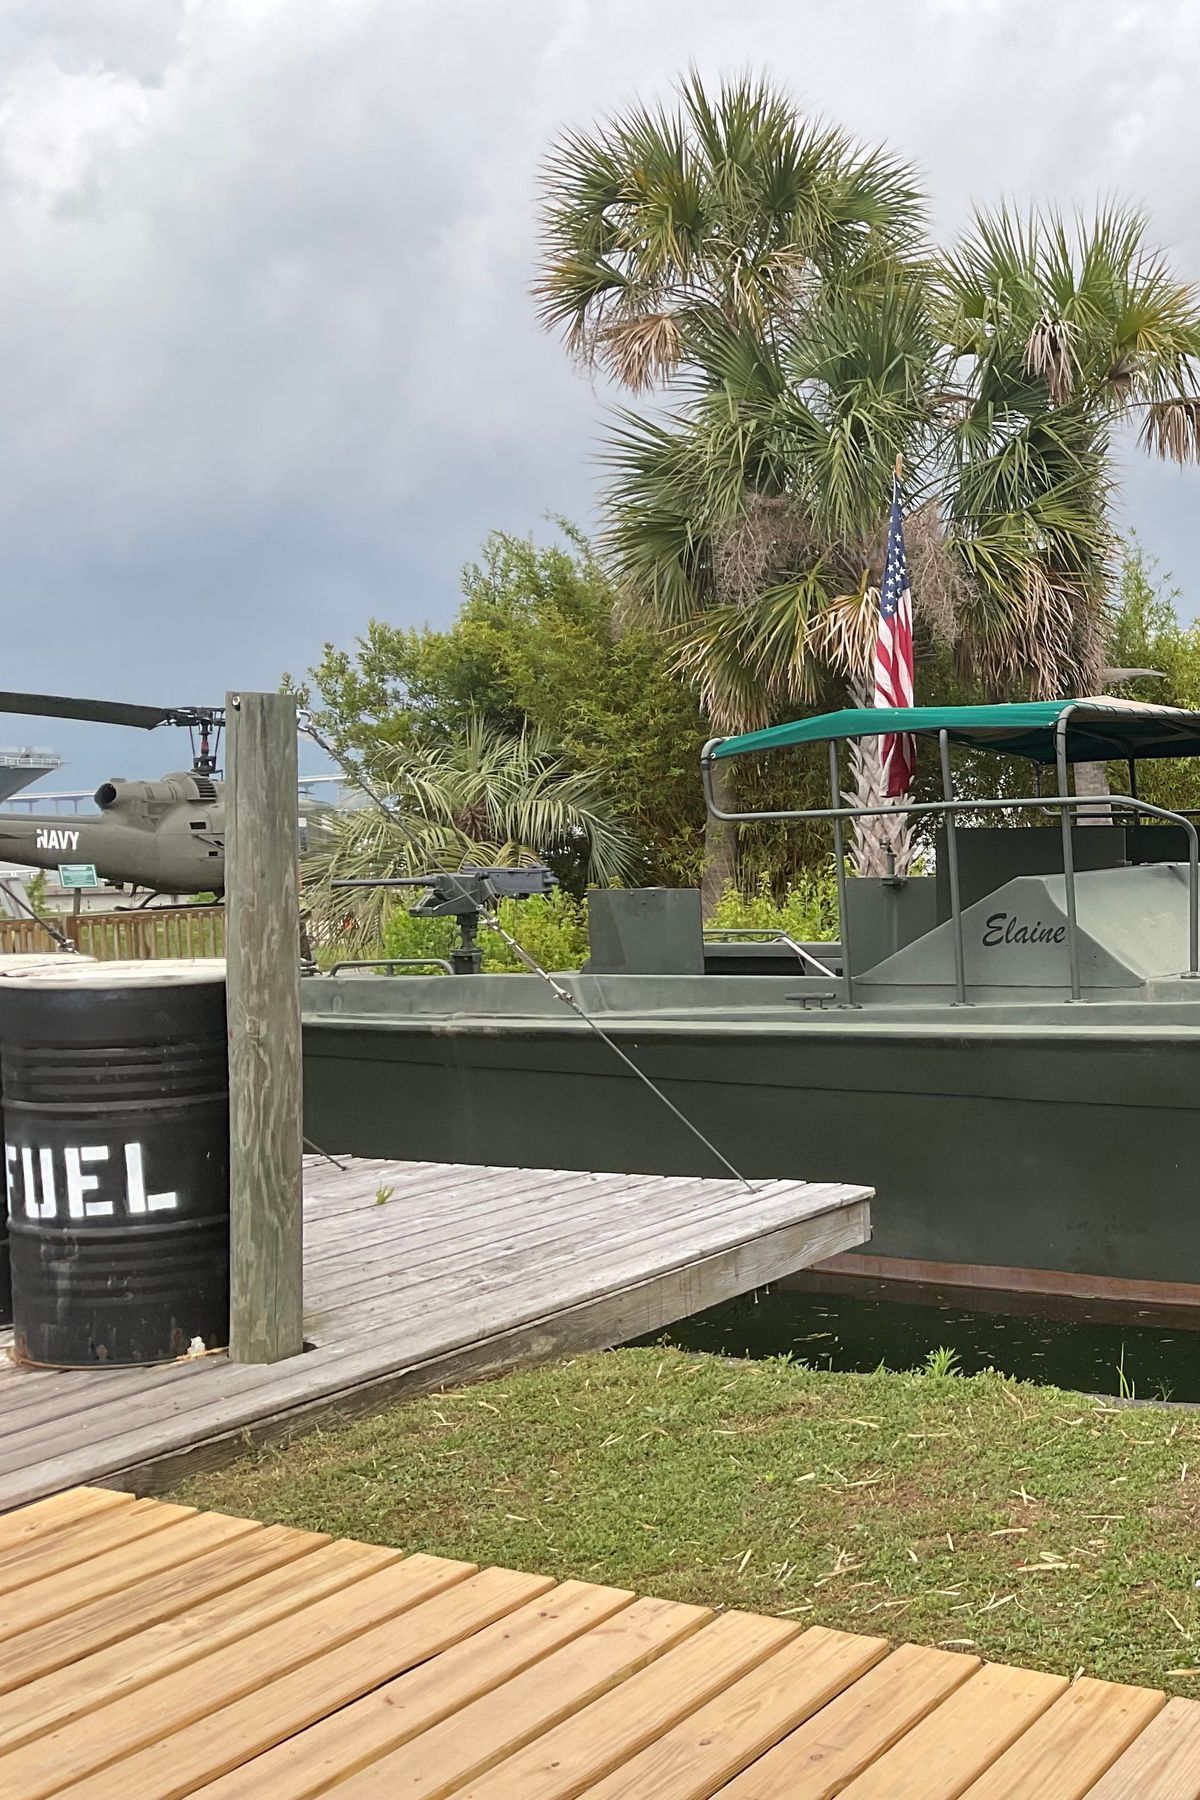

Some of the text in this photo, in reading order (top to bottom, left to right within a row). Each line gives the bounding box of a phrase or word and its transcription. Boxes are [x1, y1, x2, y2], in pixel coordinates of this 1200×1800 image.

[36, 828, 80, 850] NAVY
[982, 912, 1066, 947] Elaine
[4, 1142, 178, 1219] FUEL
